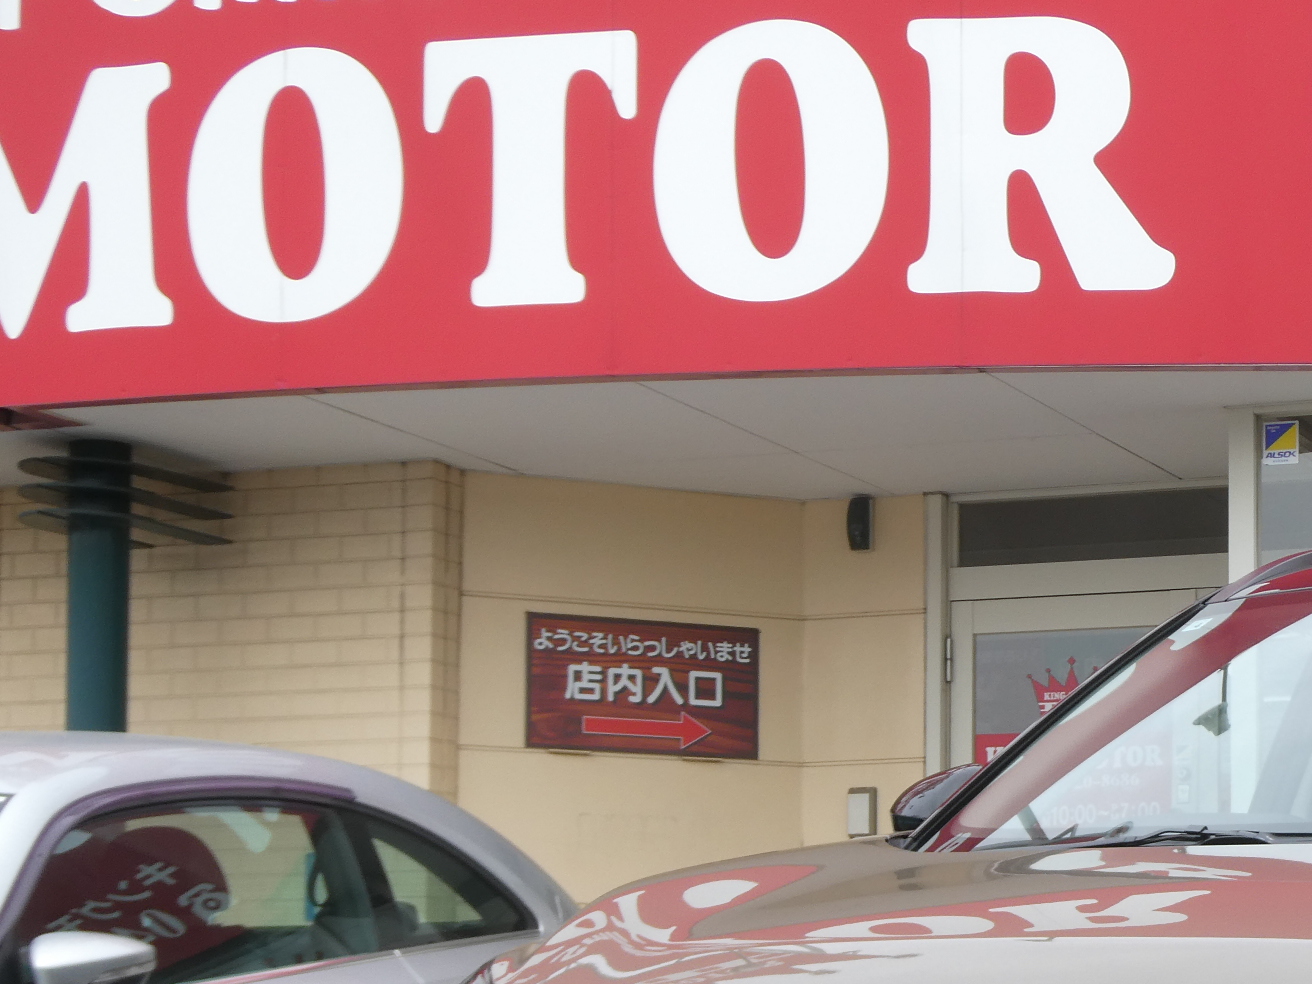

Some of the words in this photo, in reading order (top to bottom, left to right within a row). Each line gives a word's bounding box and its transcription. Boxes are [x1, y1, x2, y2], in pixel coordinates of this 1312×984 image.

[1266, 451, 1297, 459] ALSOK
[533, 628, 753, 663] ようこそいらっしゃいませ
[564, 662, 723, 707] 店内入口
[1043, 692, 1067, 700] KING
